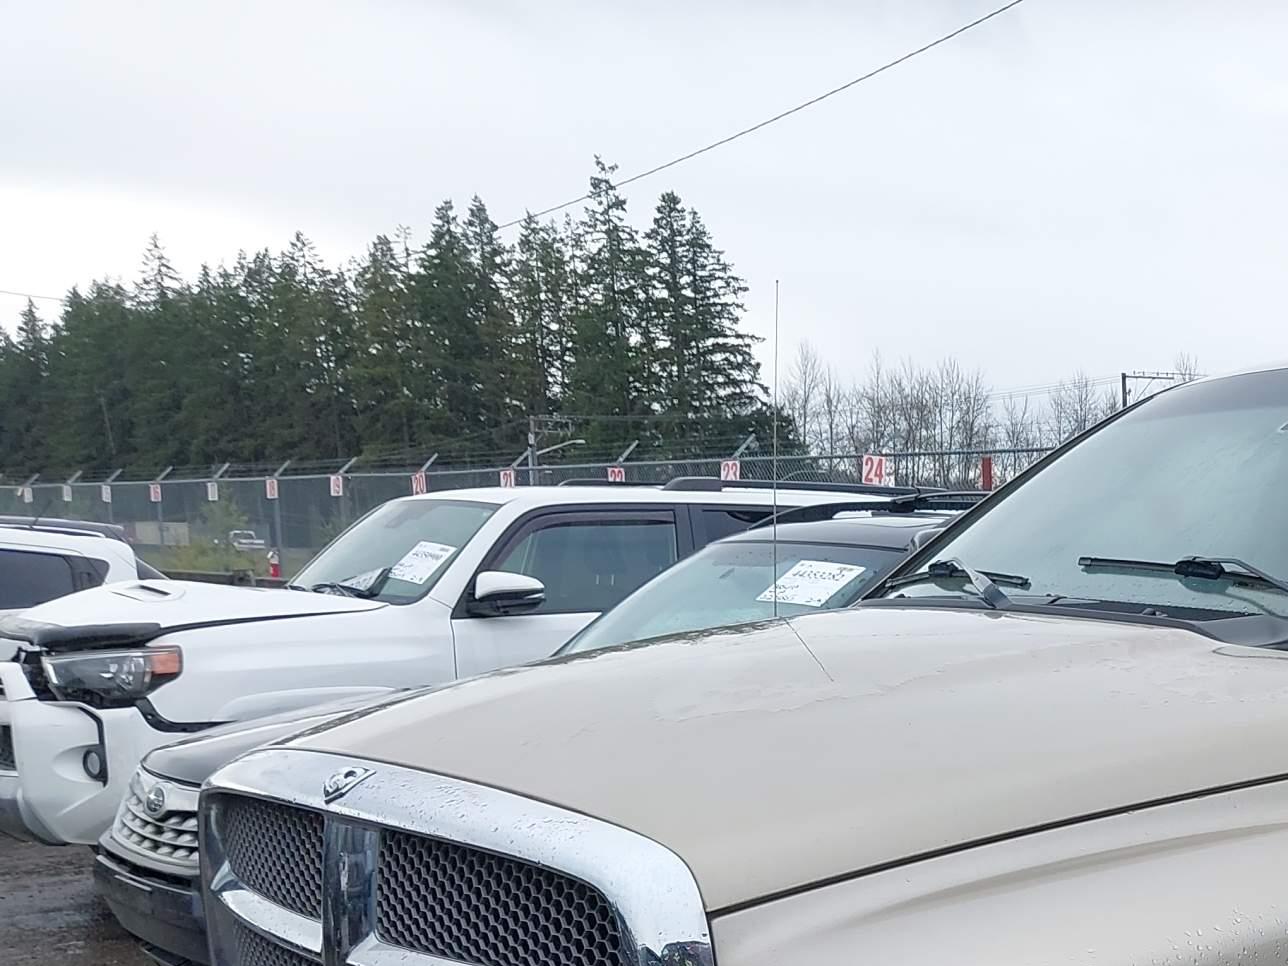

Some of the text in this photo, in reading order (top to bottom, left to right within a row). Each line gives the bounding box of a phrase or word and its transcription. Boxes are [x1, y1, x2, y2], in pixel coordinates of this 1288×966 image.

[723, 462, 737, 481] 23
[864, 456, 884, 484] 24
[413, 476, 425, 495] 20
